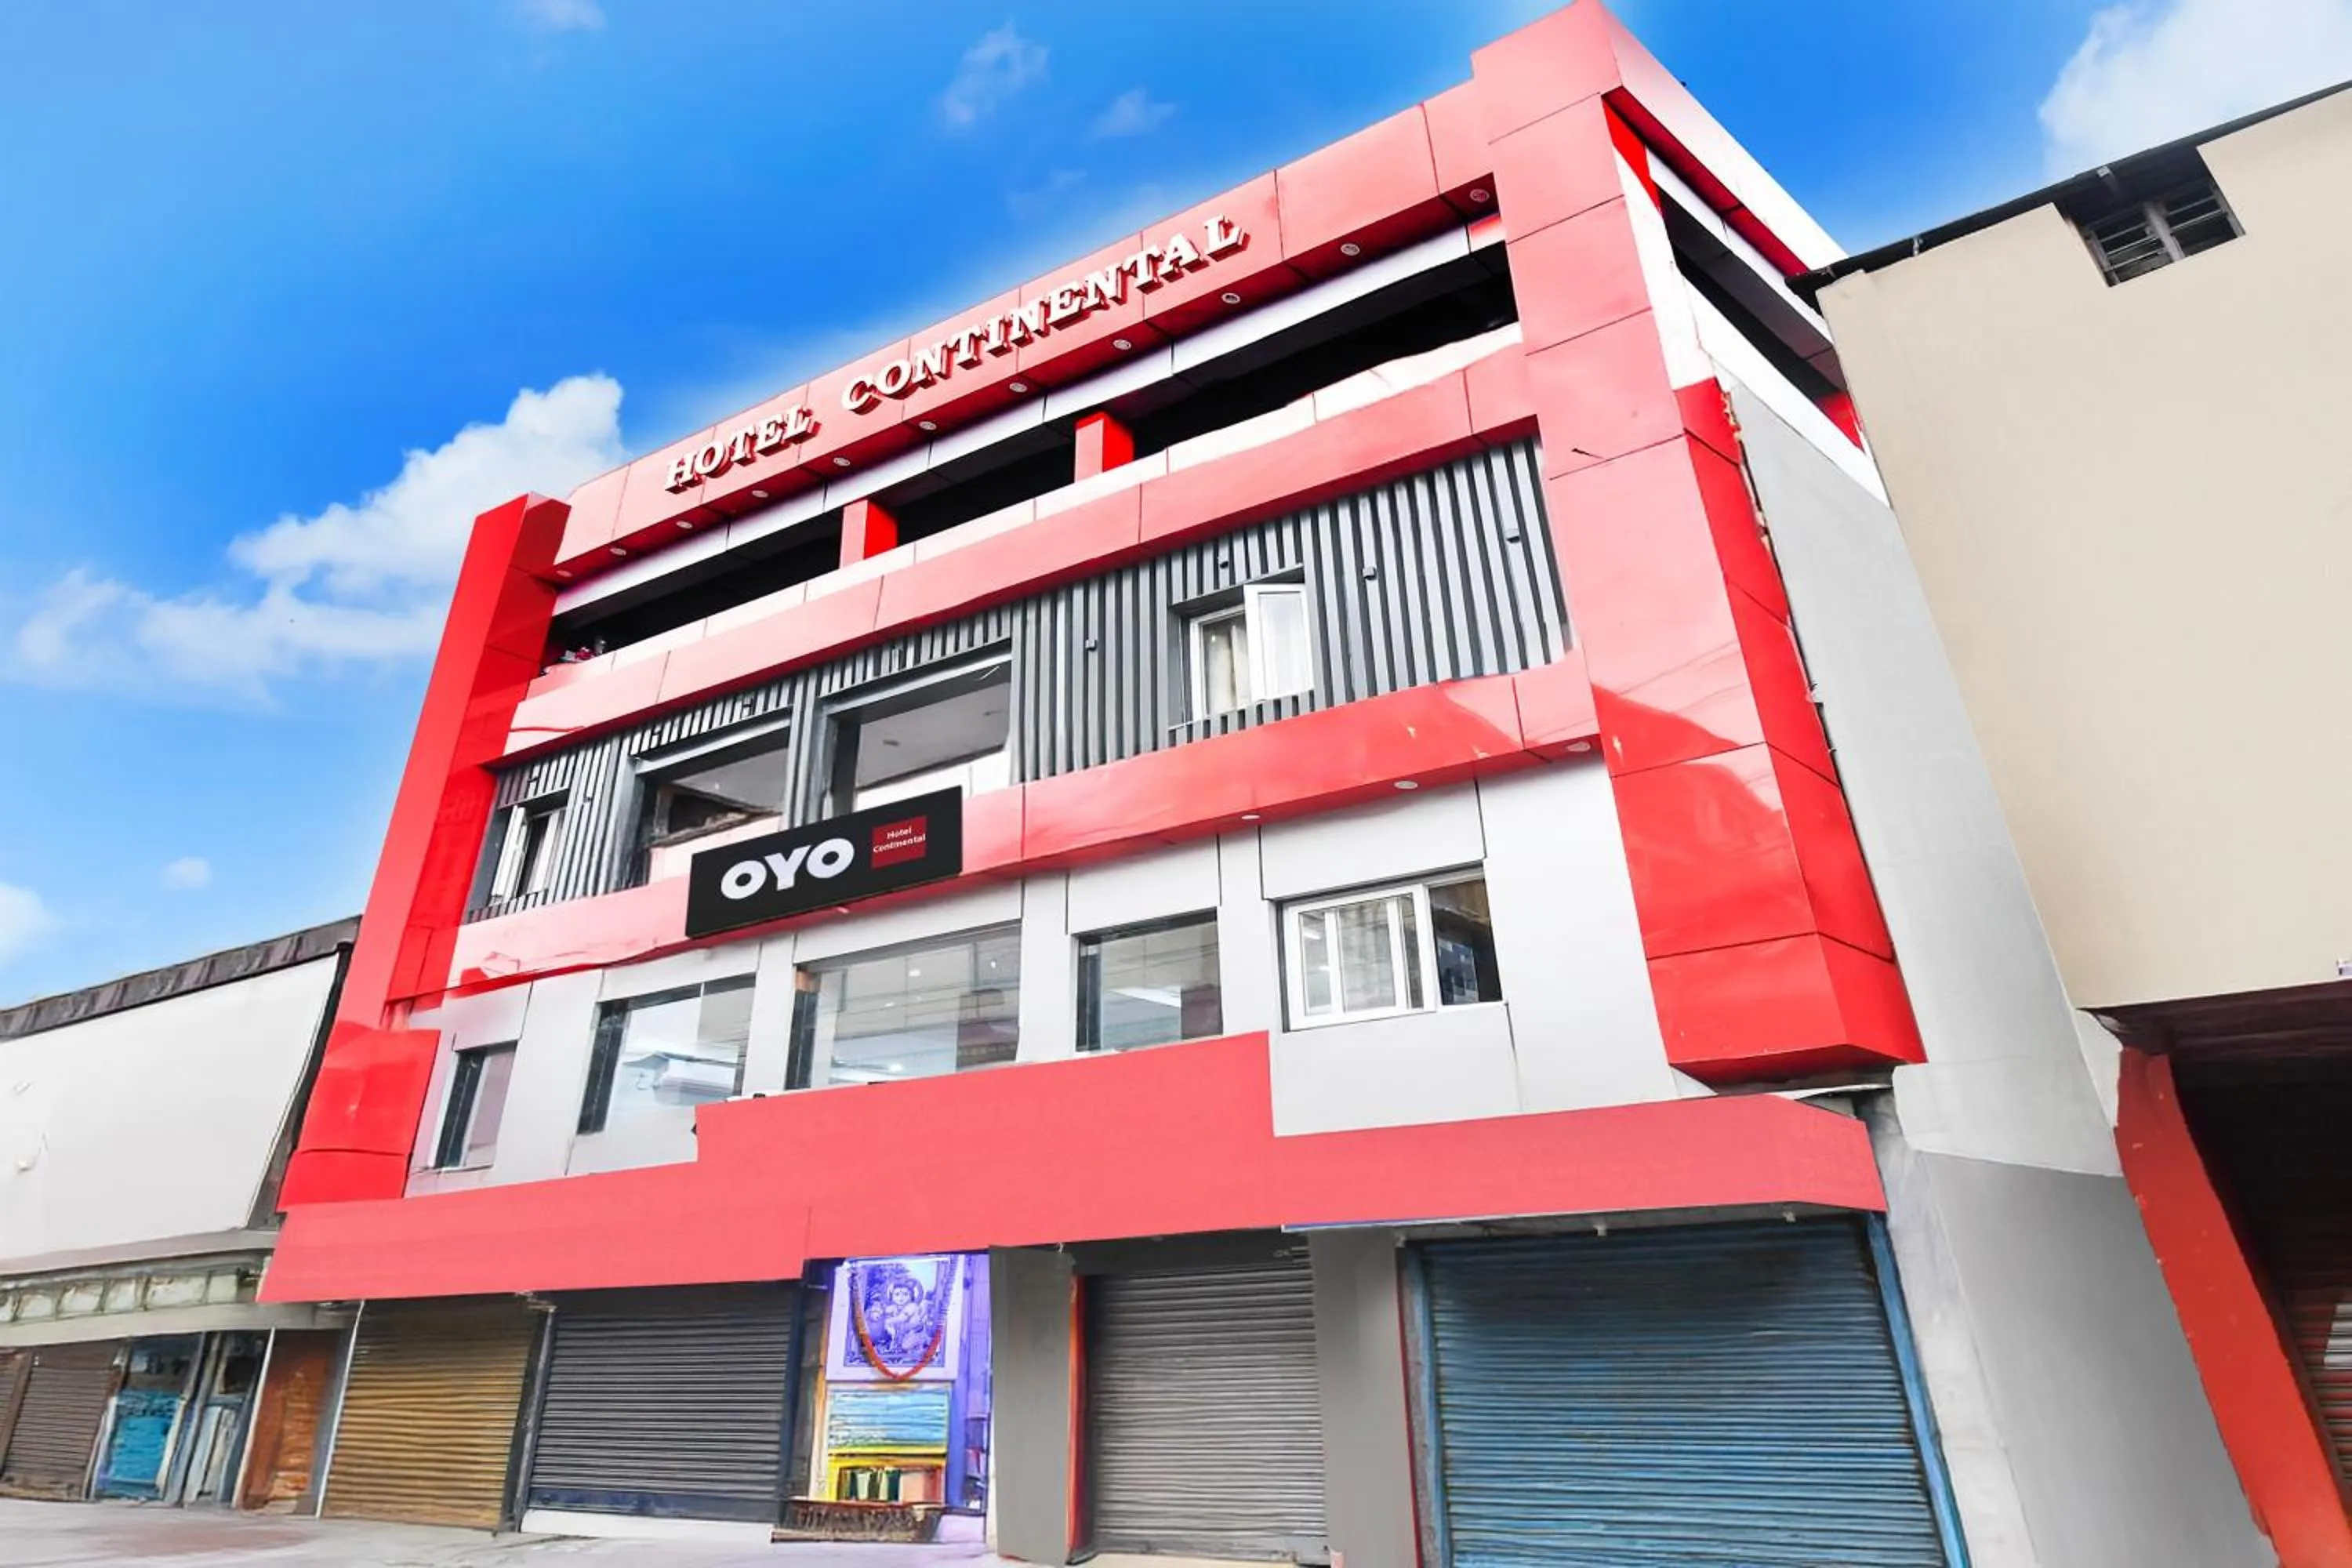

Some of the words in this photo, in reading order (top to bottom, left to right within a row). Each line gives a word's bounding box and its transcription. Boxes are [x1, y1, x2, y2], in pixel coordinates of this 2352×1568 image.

[665, 405, 820, 491] HOTEL
[841, 214, 1247, 413] CONTINENTAL
[873, 833, 926, 853] Continental
[887, 826, 912, 840] Hotel
[720, 838, 855, 899] OYO
